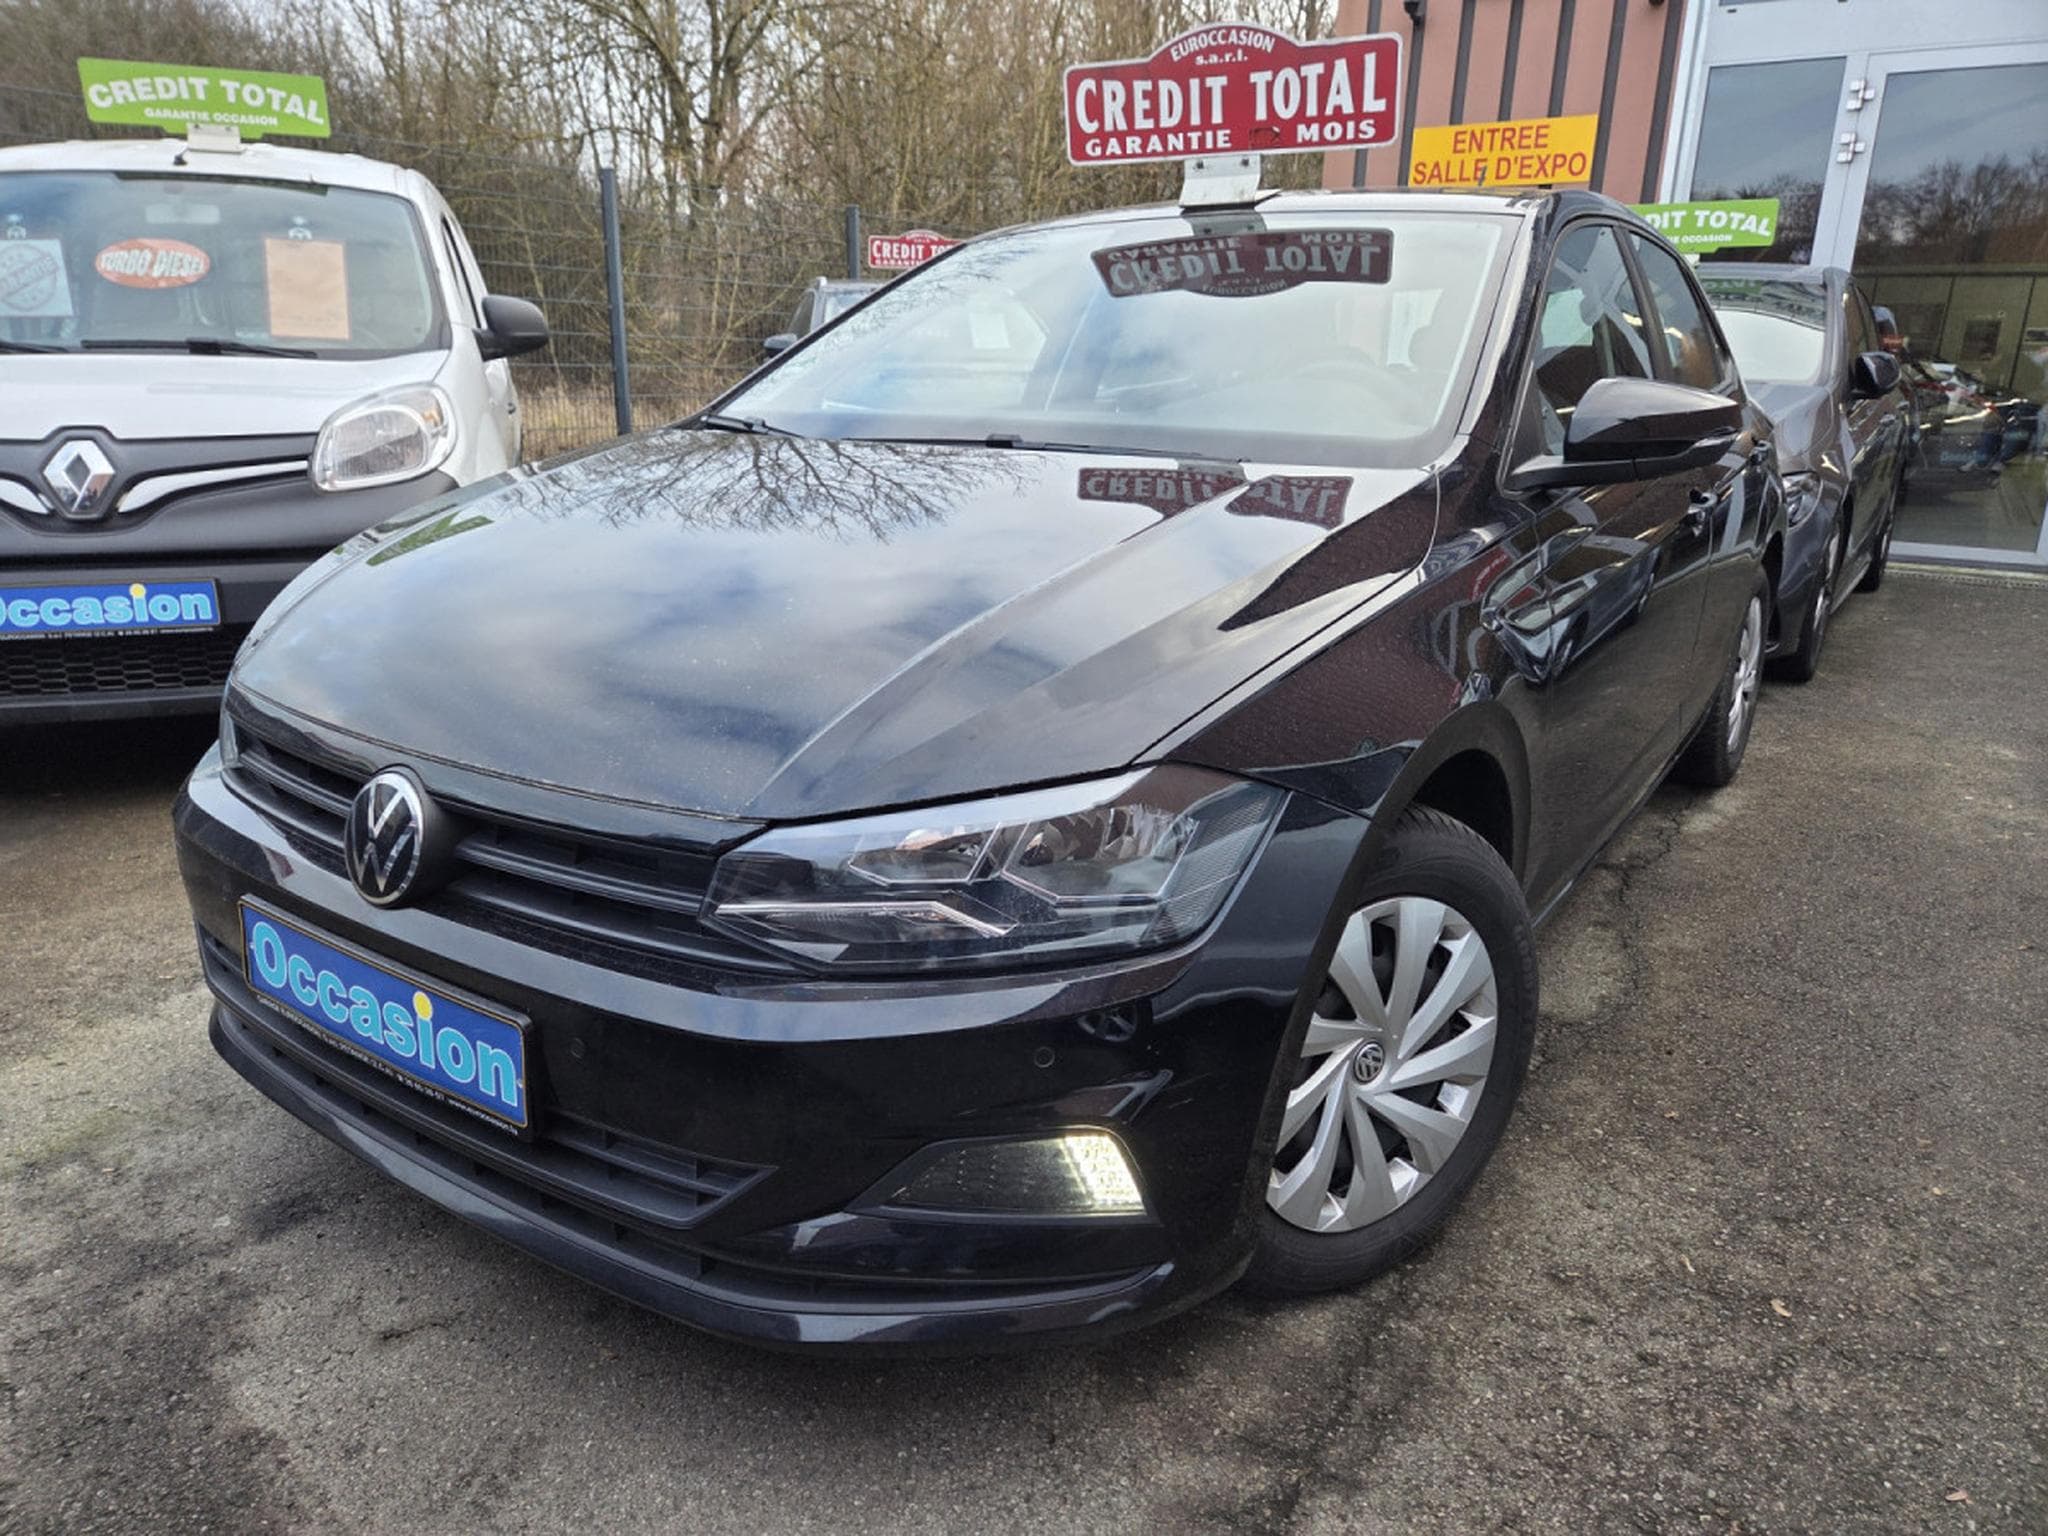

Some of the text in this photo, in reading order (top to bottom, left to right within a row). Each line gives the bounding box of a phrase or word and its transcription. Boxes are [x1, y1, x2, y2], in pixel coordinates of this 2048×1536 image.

[1170, 28, 1275, 62] EUROCCASION
[1195, 49, 1248, 66] s.a.r.l.
[88, 75, 325, 125] CREDIT TOTAL
[1075, 52, 1387, 134] CREDIT TOTAL
[144, 106, 279, 126] GARANTIE OCCASION
[1085, 118, 1377, 157] GARANTIE MOIS
[1452, 124, 1550, 154] ENTREE
[1413, 151, 1588, 185] SALLE D'EXPO
[1681, 233, 1733, 244] OCCASION
[1694, 209, 1771, 237] TOTAL
[100, 248, 205, 277] TURBO DIESEL
[872, 240, 925, 260] CREDIT
[0, 583, 213, 627] ccasion
[252, 921, 518, 1107] Occasion
